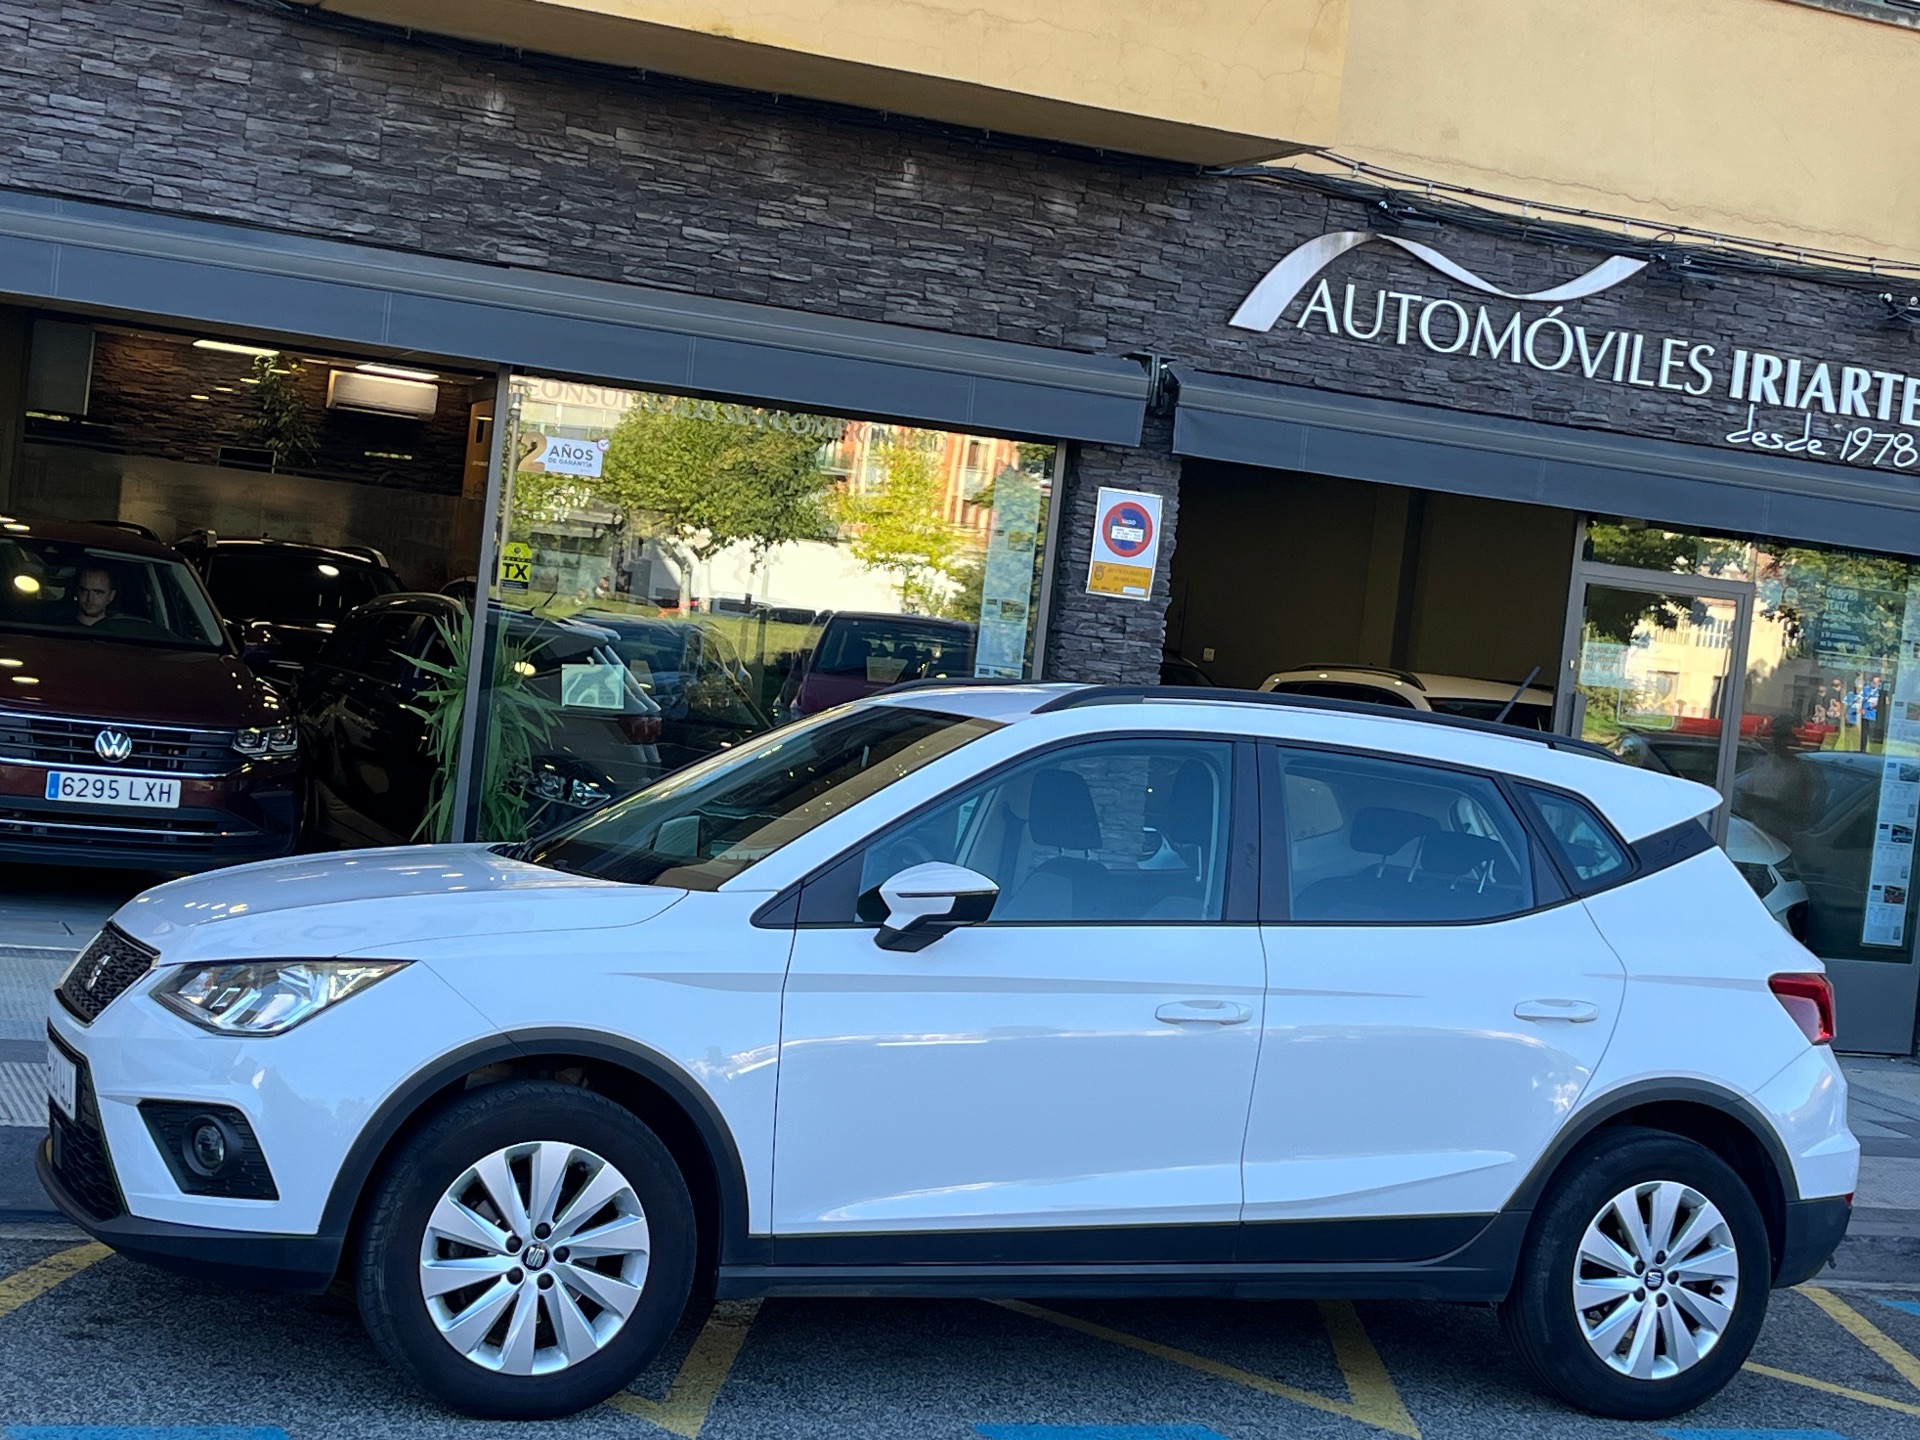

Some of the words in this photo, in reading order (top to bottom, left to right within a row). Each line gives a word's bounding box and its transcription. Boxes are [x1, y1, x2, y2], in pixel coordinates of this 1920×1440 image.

[1298, 277, 1716, 396] AUTOMÓVILES
[1729, 349, 1920, 428] IRIARTE
[517, 432, 548, 474] 2
[549, 443, 594, 461] AÑOS
[1725, 403, 1826, 455] desde
[1839, 426, 1919, 468] 1978
[502, 563, 529, 581] TX
[61, 776, 120, 800] 6295
[128, 780, 172, 803] LXH
